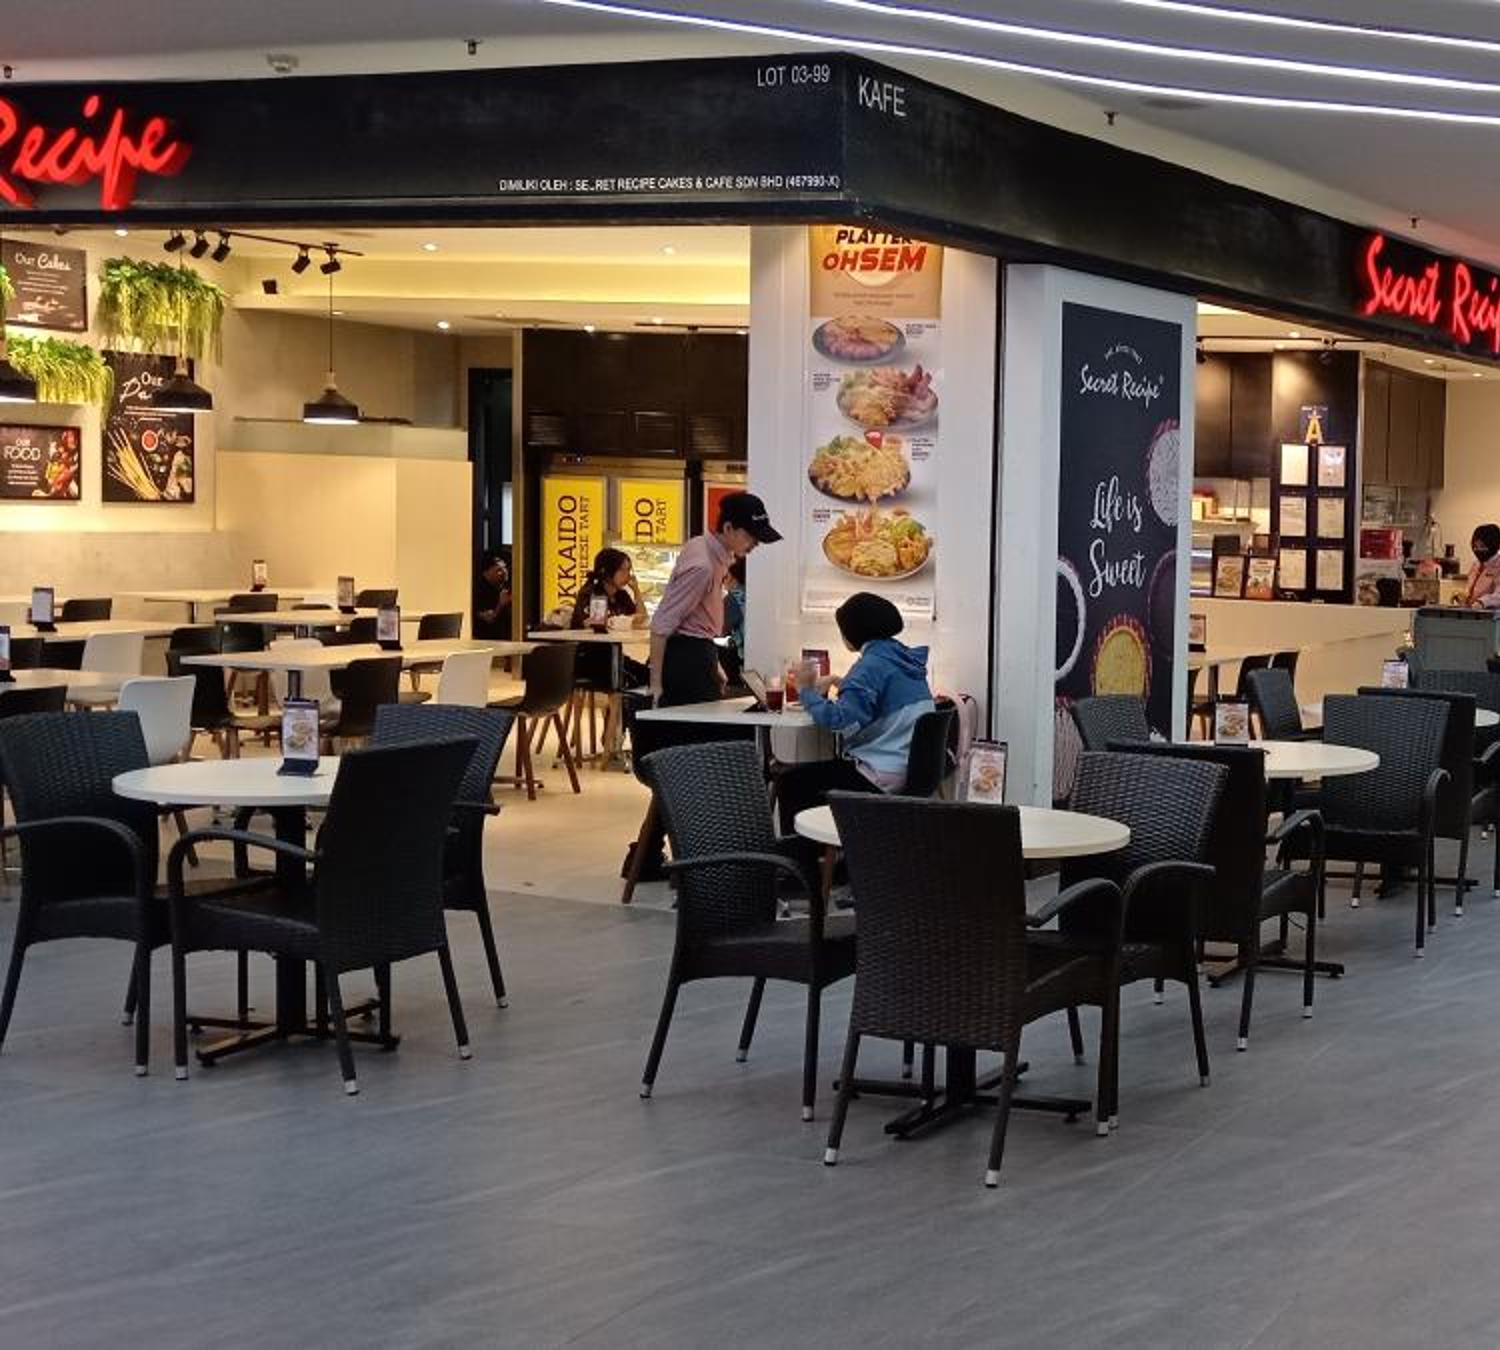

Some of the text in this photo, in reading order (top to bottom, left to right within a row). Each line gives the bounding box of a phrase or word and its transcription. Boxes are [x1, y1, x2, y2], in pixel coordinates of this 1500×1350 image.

[756, 64, 831, 88] LOT 03-99
[858, 75, 908, 118] KAFE
[575, 178, 616, 191] SERET
[617, 177, 656, 190] RECIPE
[657, 176, 693, 189] CAKES
[705, 176, 734, 189] CAFE
[735, 176, 759, 189] SDN
[822, 246, 928, 272] OHSEM
[1362, 233, 1442, 324] Secret
[1079, 363, 1161, 409] Secret Recipe
[3, 445, 41, 461] FOOD
[1089, 475, 1143, 533] Life is
[557, 494, 578, 607] KKAIDO
[1088, 538, 1147, 598] Sweet
